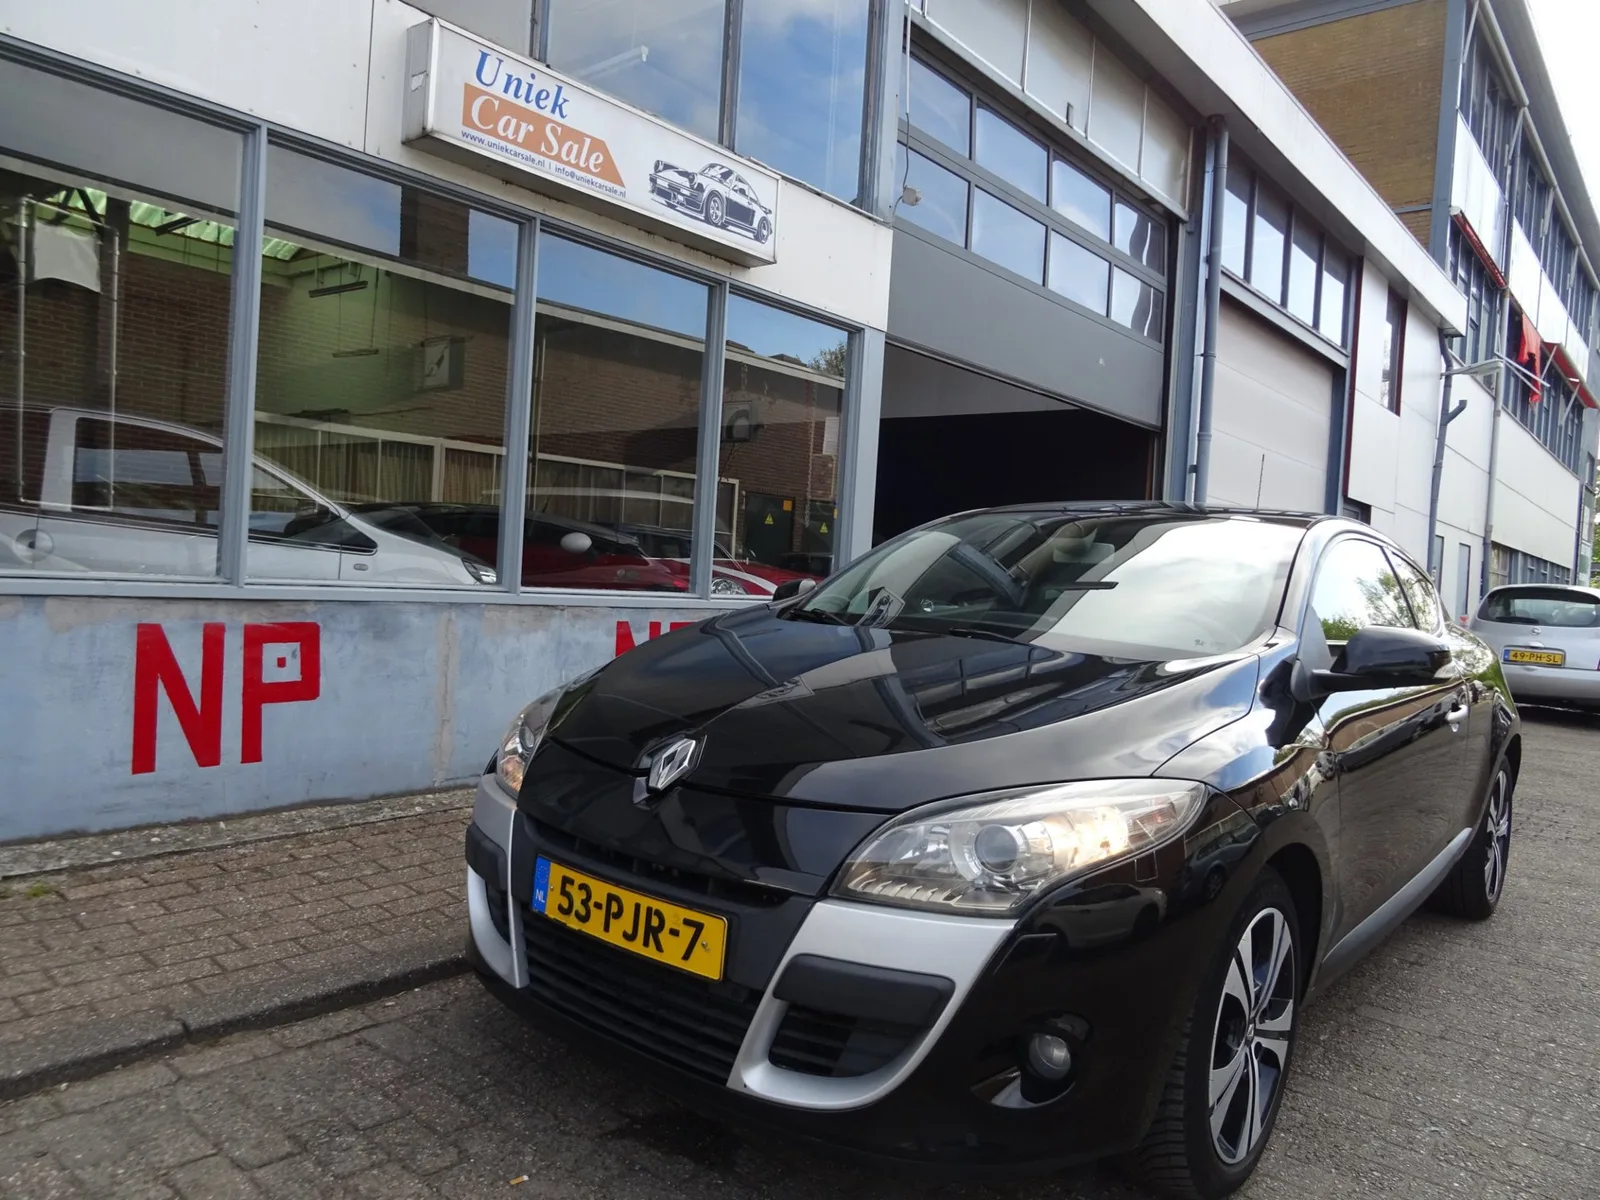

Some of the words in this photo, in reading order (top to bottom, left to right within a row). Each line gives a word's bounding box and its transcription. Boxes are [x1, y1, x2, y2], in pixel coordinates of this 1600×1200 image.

[475, 49, 570, 119] Uniek
[461, 130, 545, 168] www.uniekcarsale.nl
[555, 164, 627, 199] info@uniekcarsale.nl
[471, 95, 535, 143] Car
[540, 122, 604, 173] Sale
[1511, 652, 1559, 663] 49-PH-SL
[132, 621, 321, 775] NP
[534, 887, 547, 904] NL
[557, 874, 706, 962] 53-PJR-7
